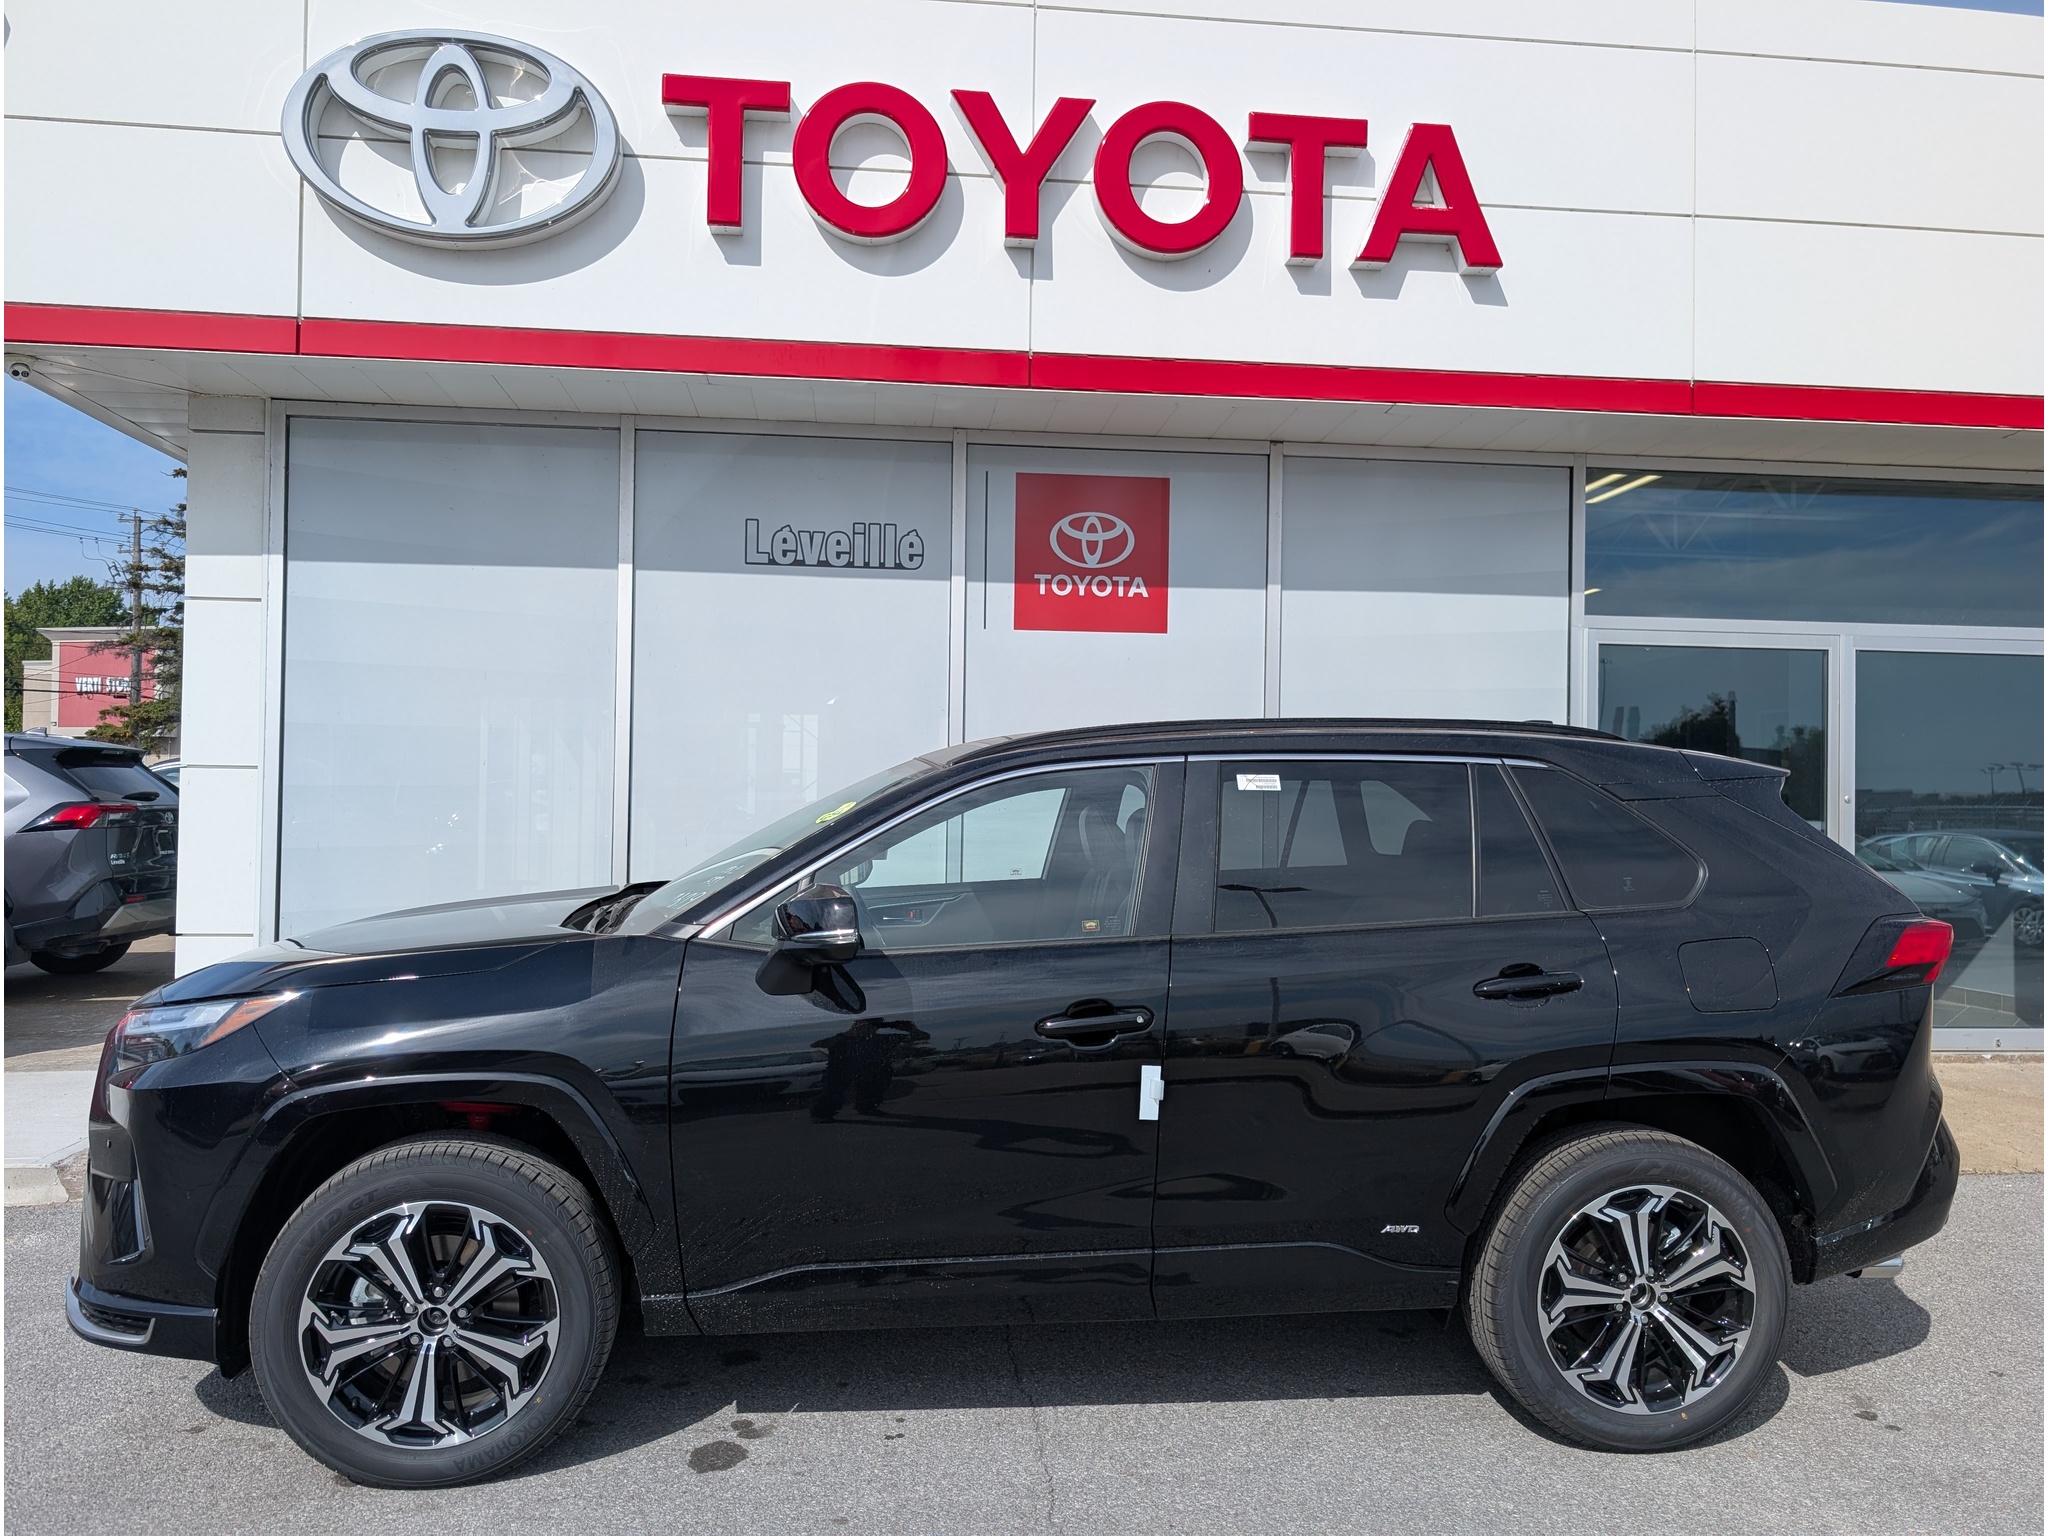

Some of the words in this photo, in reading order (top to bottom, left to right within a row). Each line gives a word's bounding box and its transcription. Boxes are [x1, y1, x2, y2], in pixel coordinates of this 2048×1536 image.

[662, 73, 1504, 275] TOYOTA
[745, 518, 924, 570] Léveillé
[1034, 573, 1149, 598] TOYOTA
[75, 677, 101, 692] VERTI
[106, 677, 132, 692] STOR
[453, 1409, 554, 1474] YOKOHAMA
